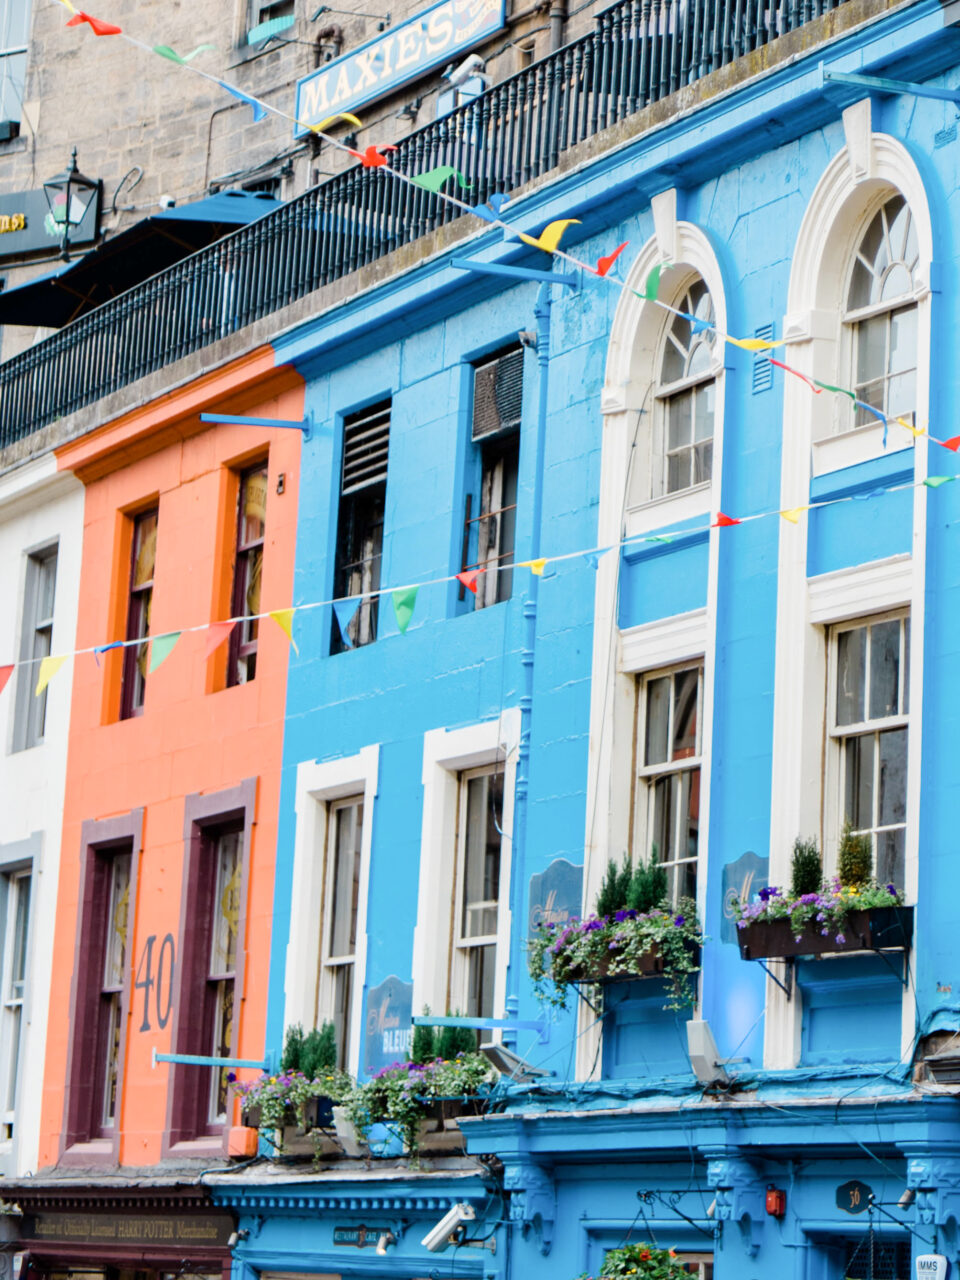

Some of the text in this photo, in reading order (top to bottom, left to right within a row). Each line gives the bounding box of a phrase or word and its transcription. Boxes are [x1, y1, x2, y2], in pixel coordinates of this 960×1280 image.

[301, 4, 454, 120] MAXIES
[135, 932, 175, 1032] 40
[118, 1221, 144, 1237] HARRY
[144, 1221, 173, 1238] POTTER
